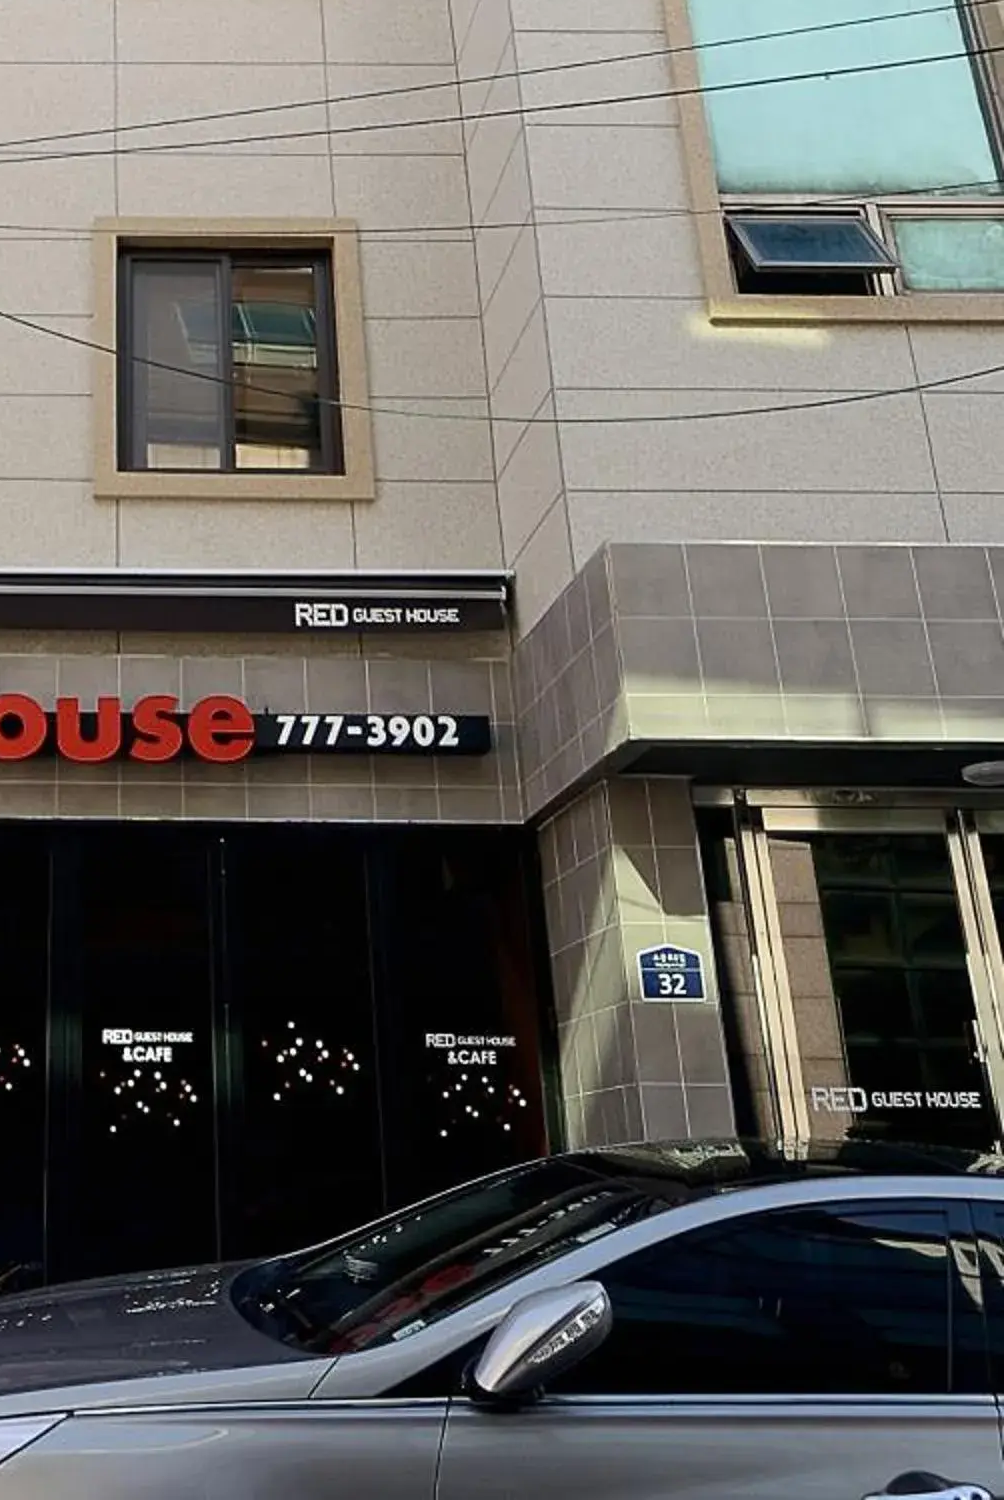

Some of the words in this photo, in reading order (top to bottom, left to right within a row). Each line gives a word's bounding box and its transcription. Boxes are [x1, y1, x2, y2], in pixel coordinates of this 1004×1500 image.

[295, 603, 349, 626] RED
[353, 607, 402, 624] GUEST
[405, 607, 459, 624] HOUSE
[275, 713, 460, 749] 777-3902
[658, 973, 687, 995] 32
[102, 1028, 133, 1044] RED
[425, 1033, 456, 1048] RED
[122, 1046, 172, 1062] &CAFE
[447, 1049, 497, 1065] &CAFE
[811, 1087, 867, 1112] RED
[872, 1092, 921, 1108] GUEST
[927, 1092, 982, 1108] HOUSE
